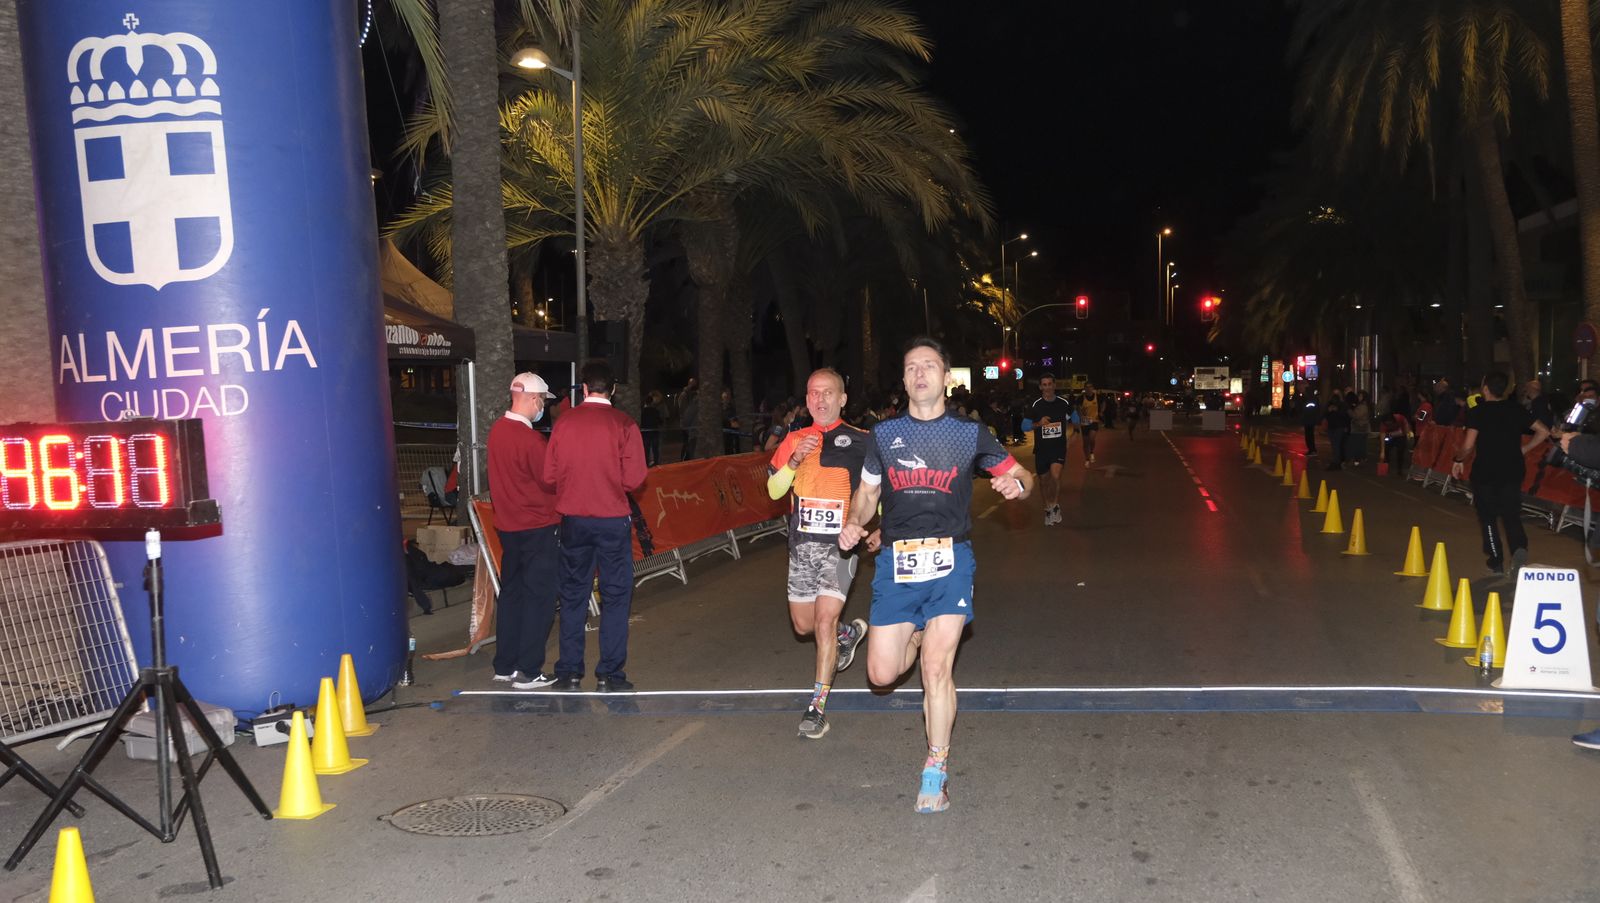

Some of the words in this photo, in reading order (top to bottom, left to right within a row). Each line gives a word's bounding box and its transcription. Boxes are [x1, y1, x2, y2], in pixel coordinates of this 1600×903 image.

[59, 308, 318, 384] ALMERÍA
[101, 384, 249, 421] CIUDAD
[806, 509, 835, 522] 159
[1524, 572, 1575, 582] MONDO
[1531, 603, 1567, 655] 5
